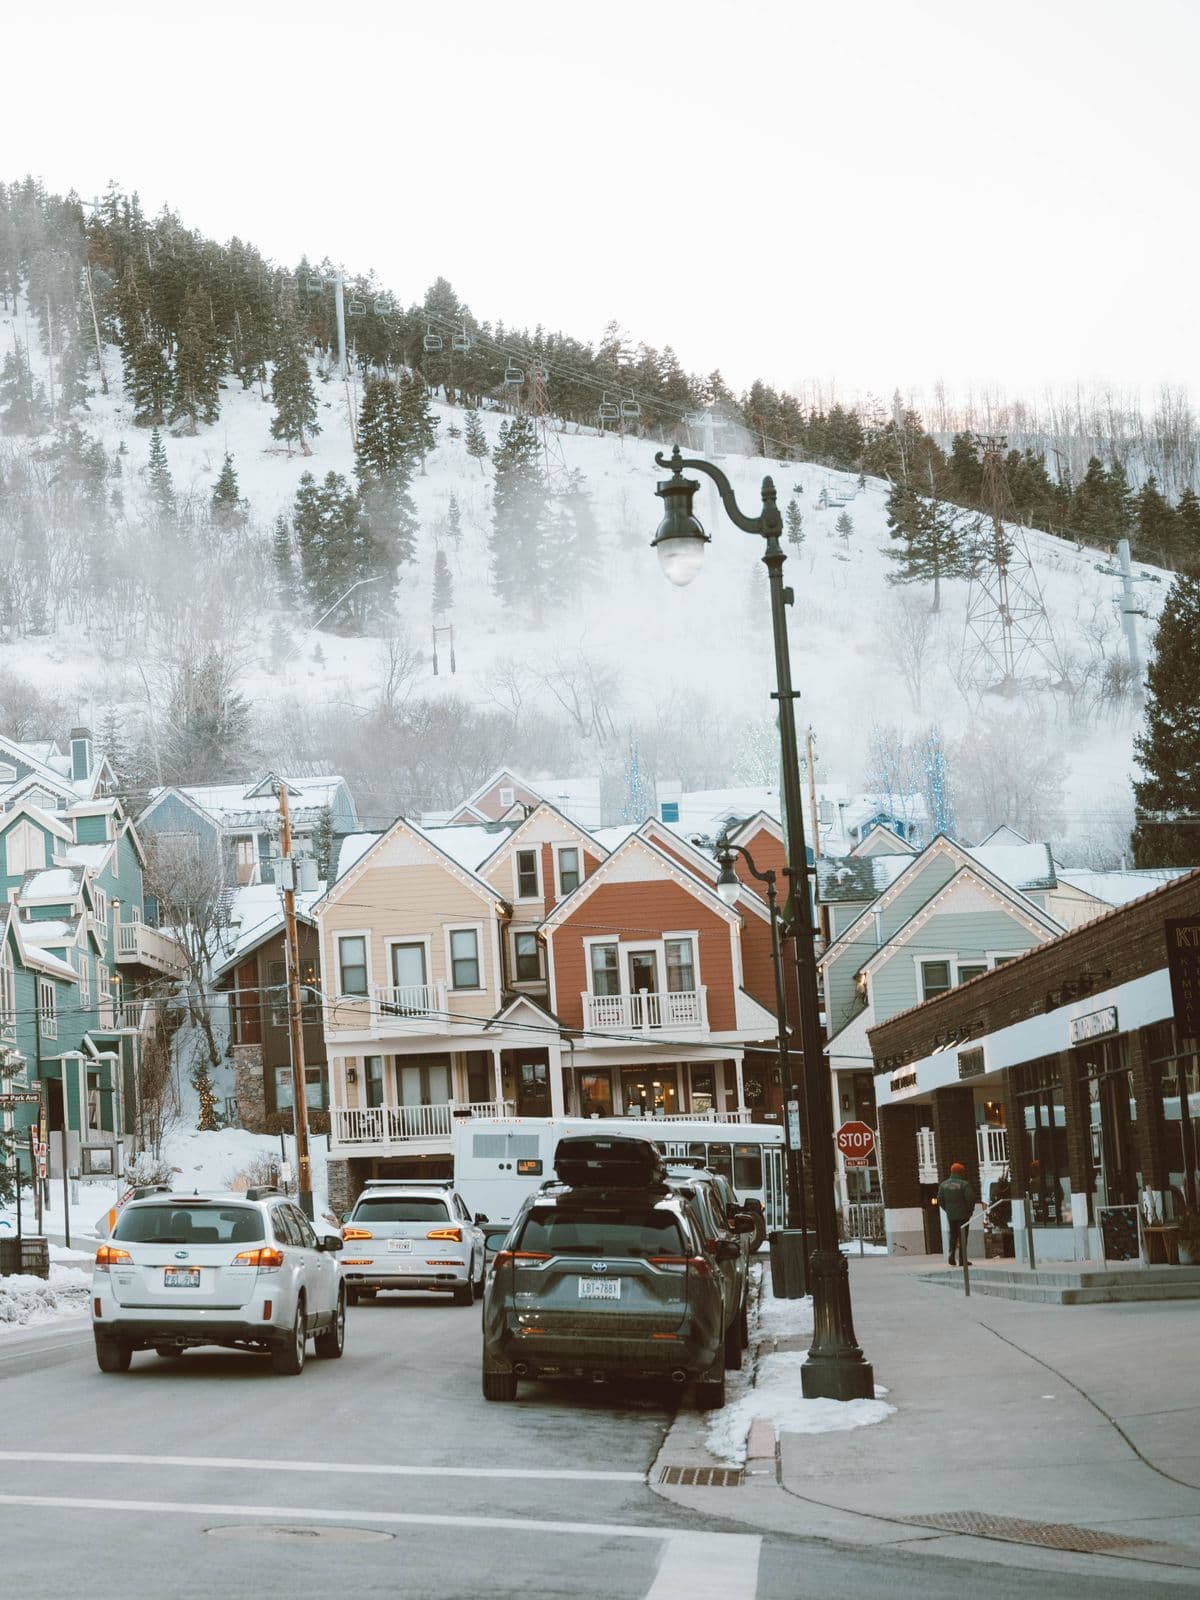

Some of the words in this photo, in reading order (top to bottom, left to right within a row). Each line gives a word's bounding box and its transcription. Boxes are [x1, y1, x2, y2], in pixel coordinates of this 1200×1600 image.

[10, 1093, 25, 1101] Park
[26, 1093, 38, 1101] Ave
[839, 1132, 871, 1148] STOP
